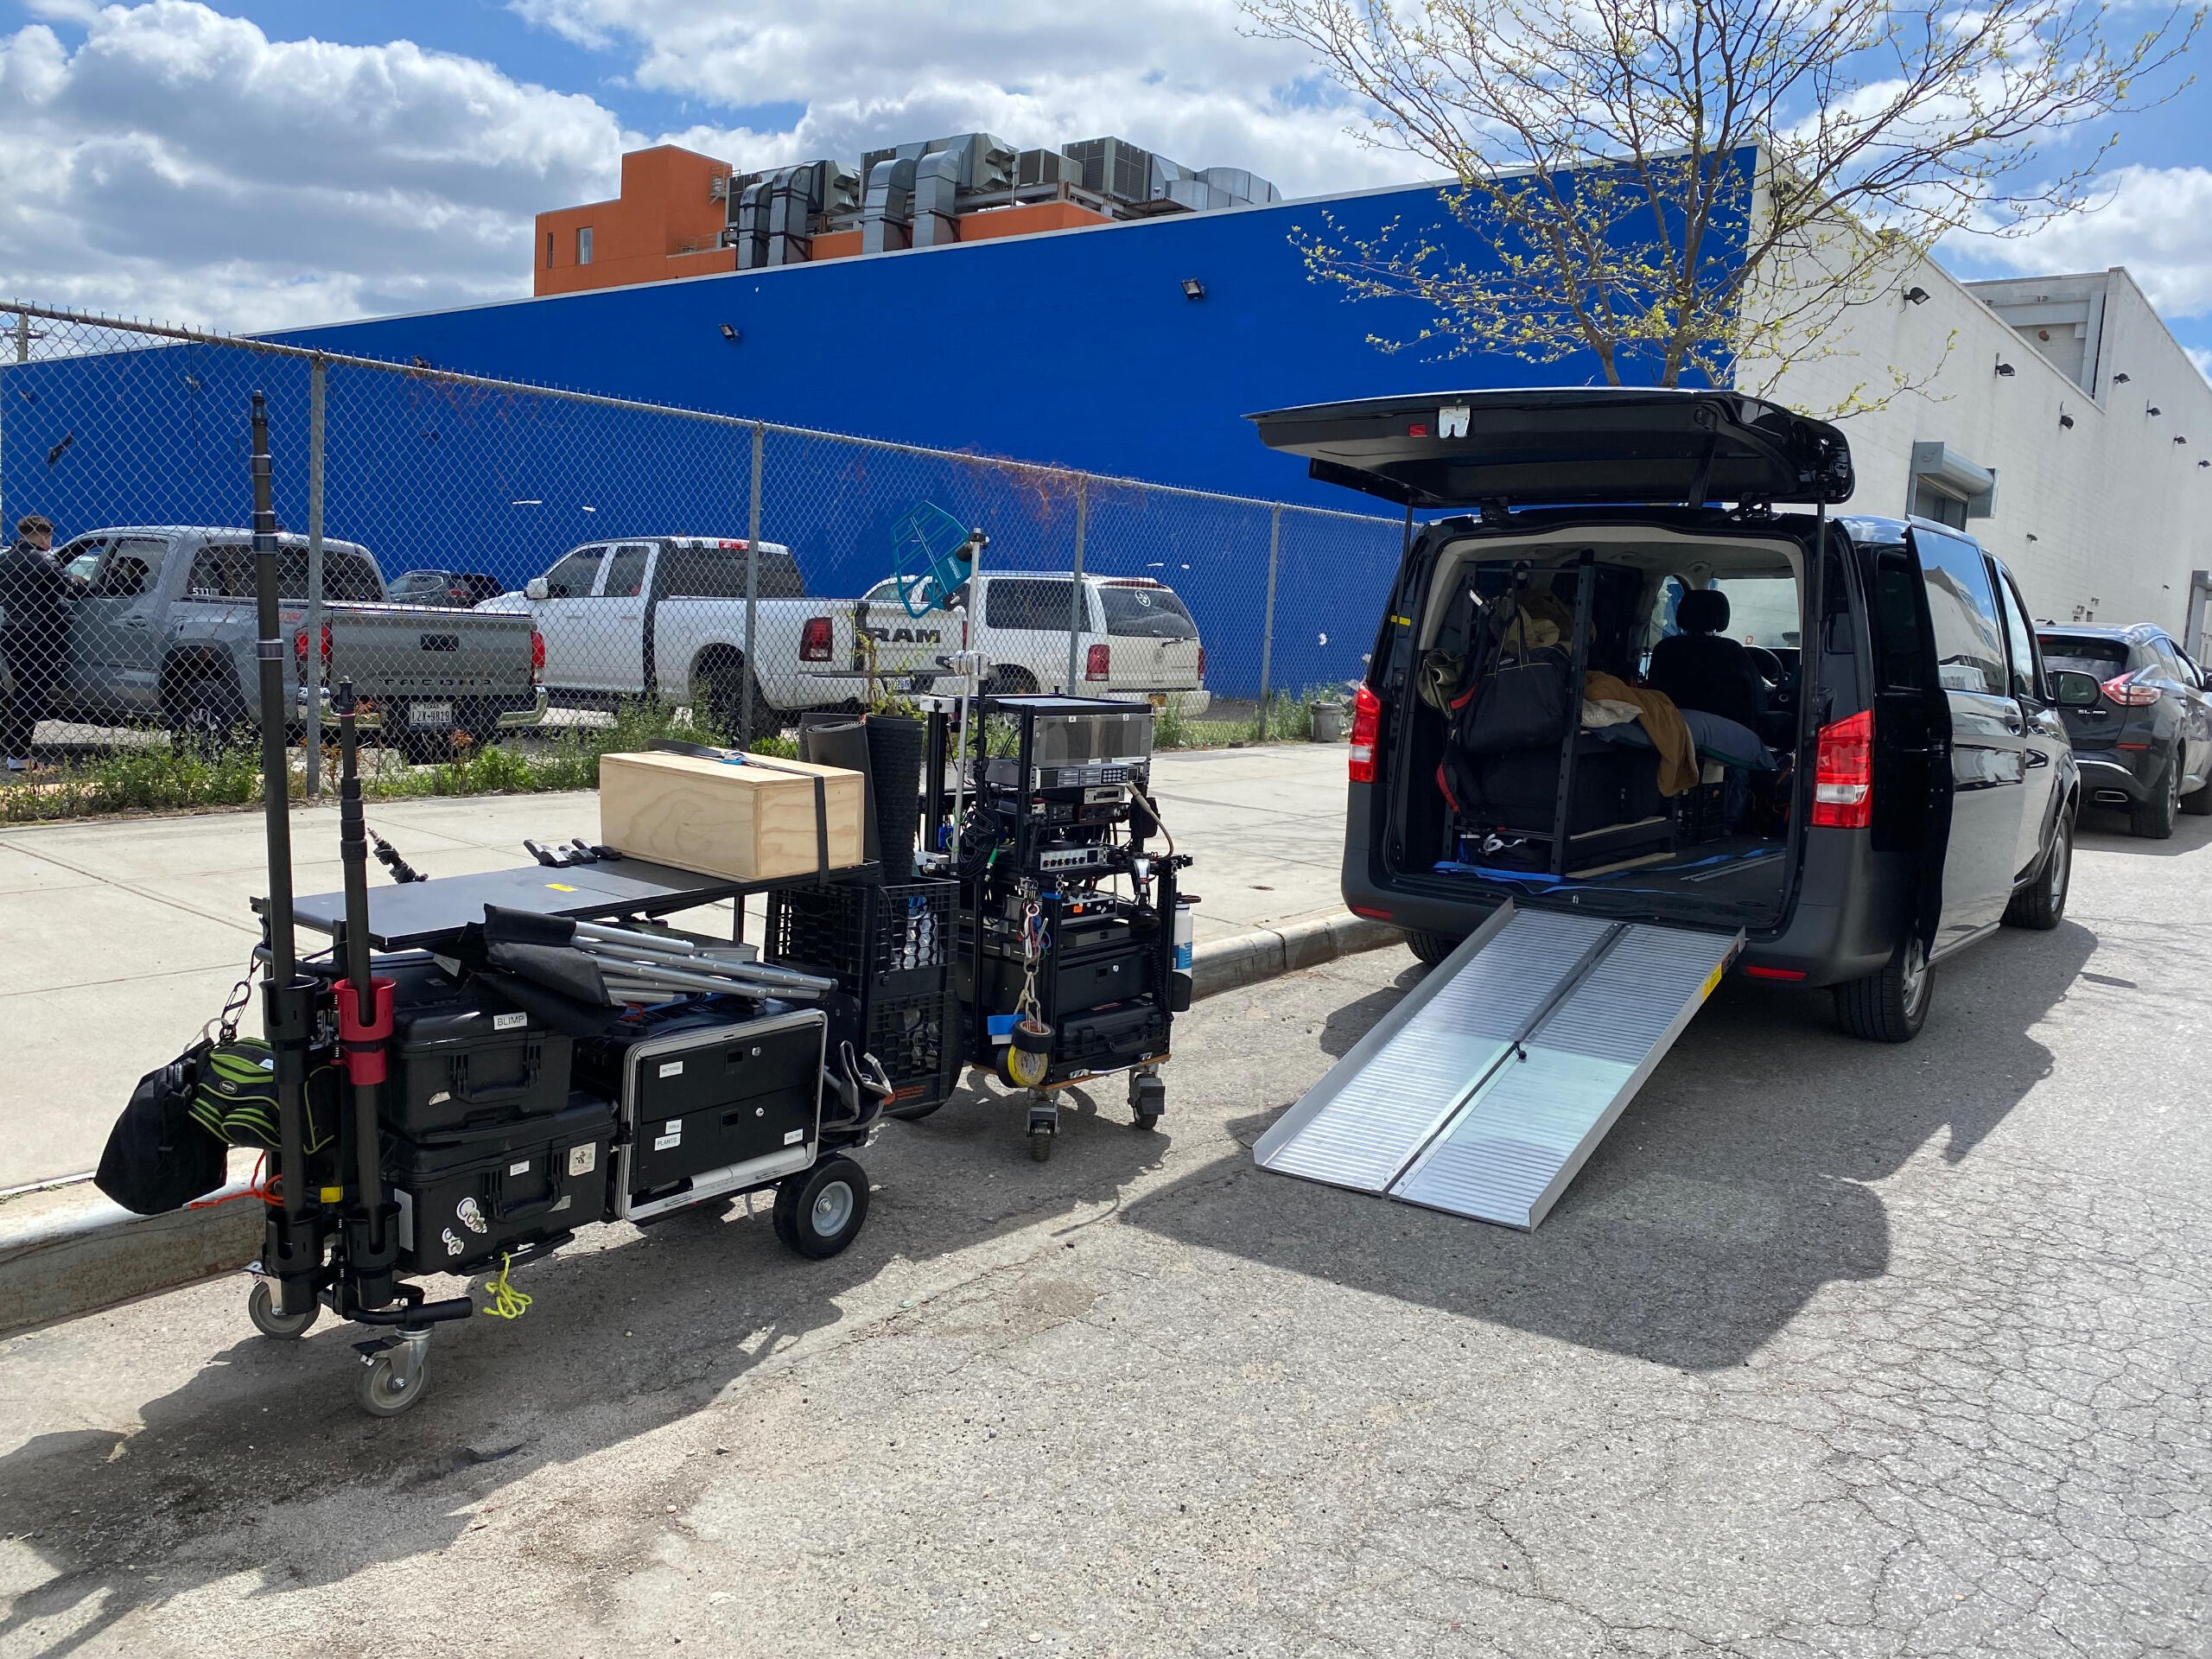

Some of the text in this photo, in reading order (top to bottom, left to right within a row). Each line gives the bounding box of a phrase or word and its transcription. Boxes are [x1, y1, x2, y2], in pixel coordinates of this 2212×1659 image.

[866, 627, 941, 643] RAM
[497, 1015, 524, 1027] BLIMP
[657, 1137, 677, 1147] PLANTS
